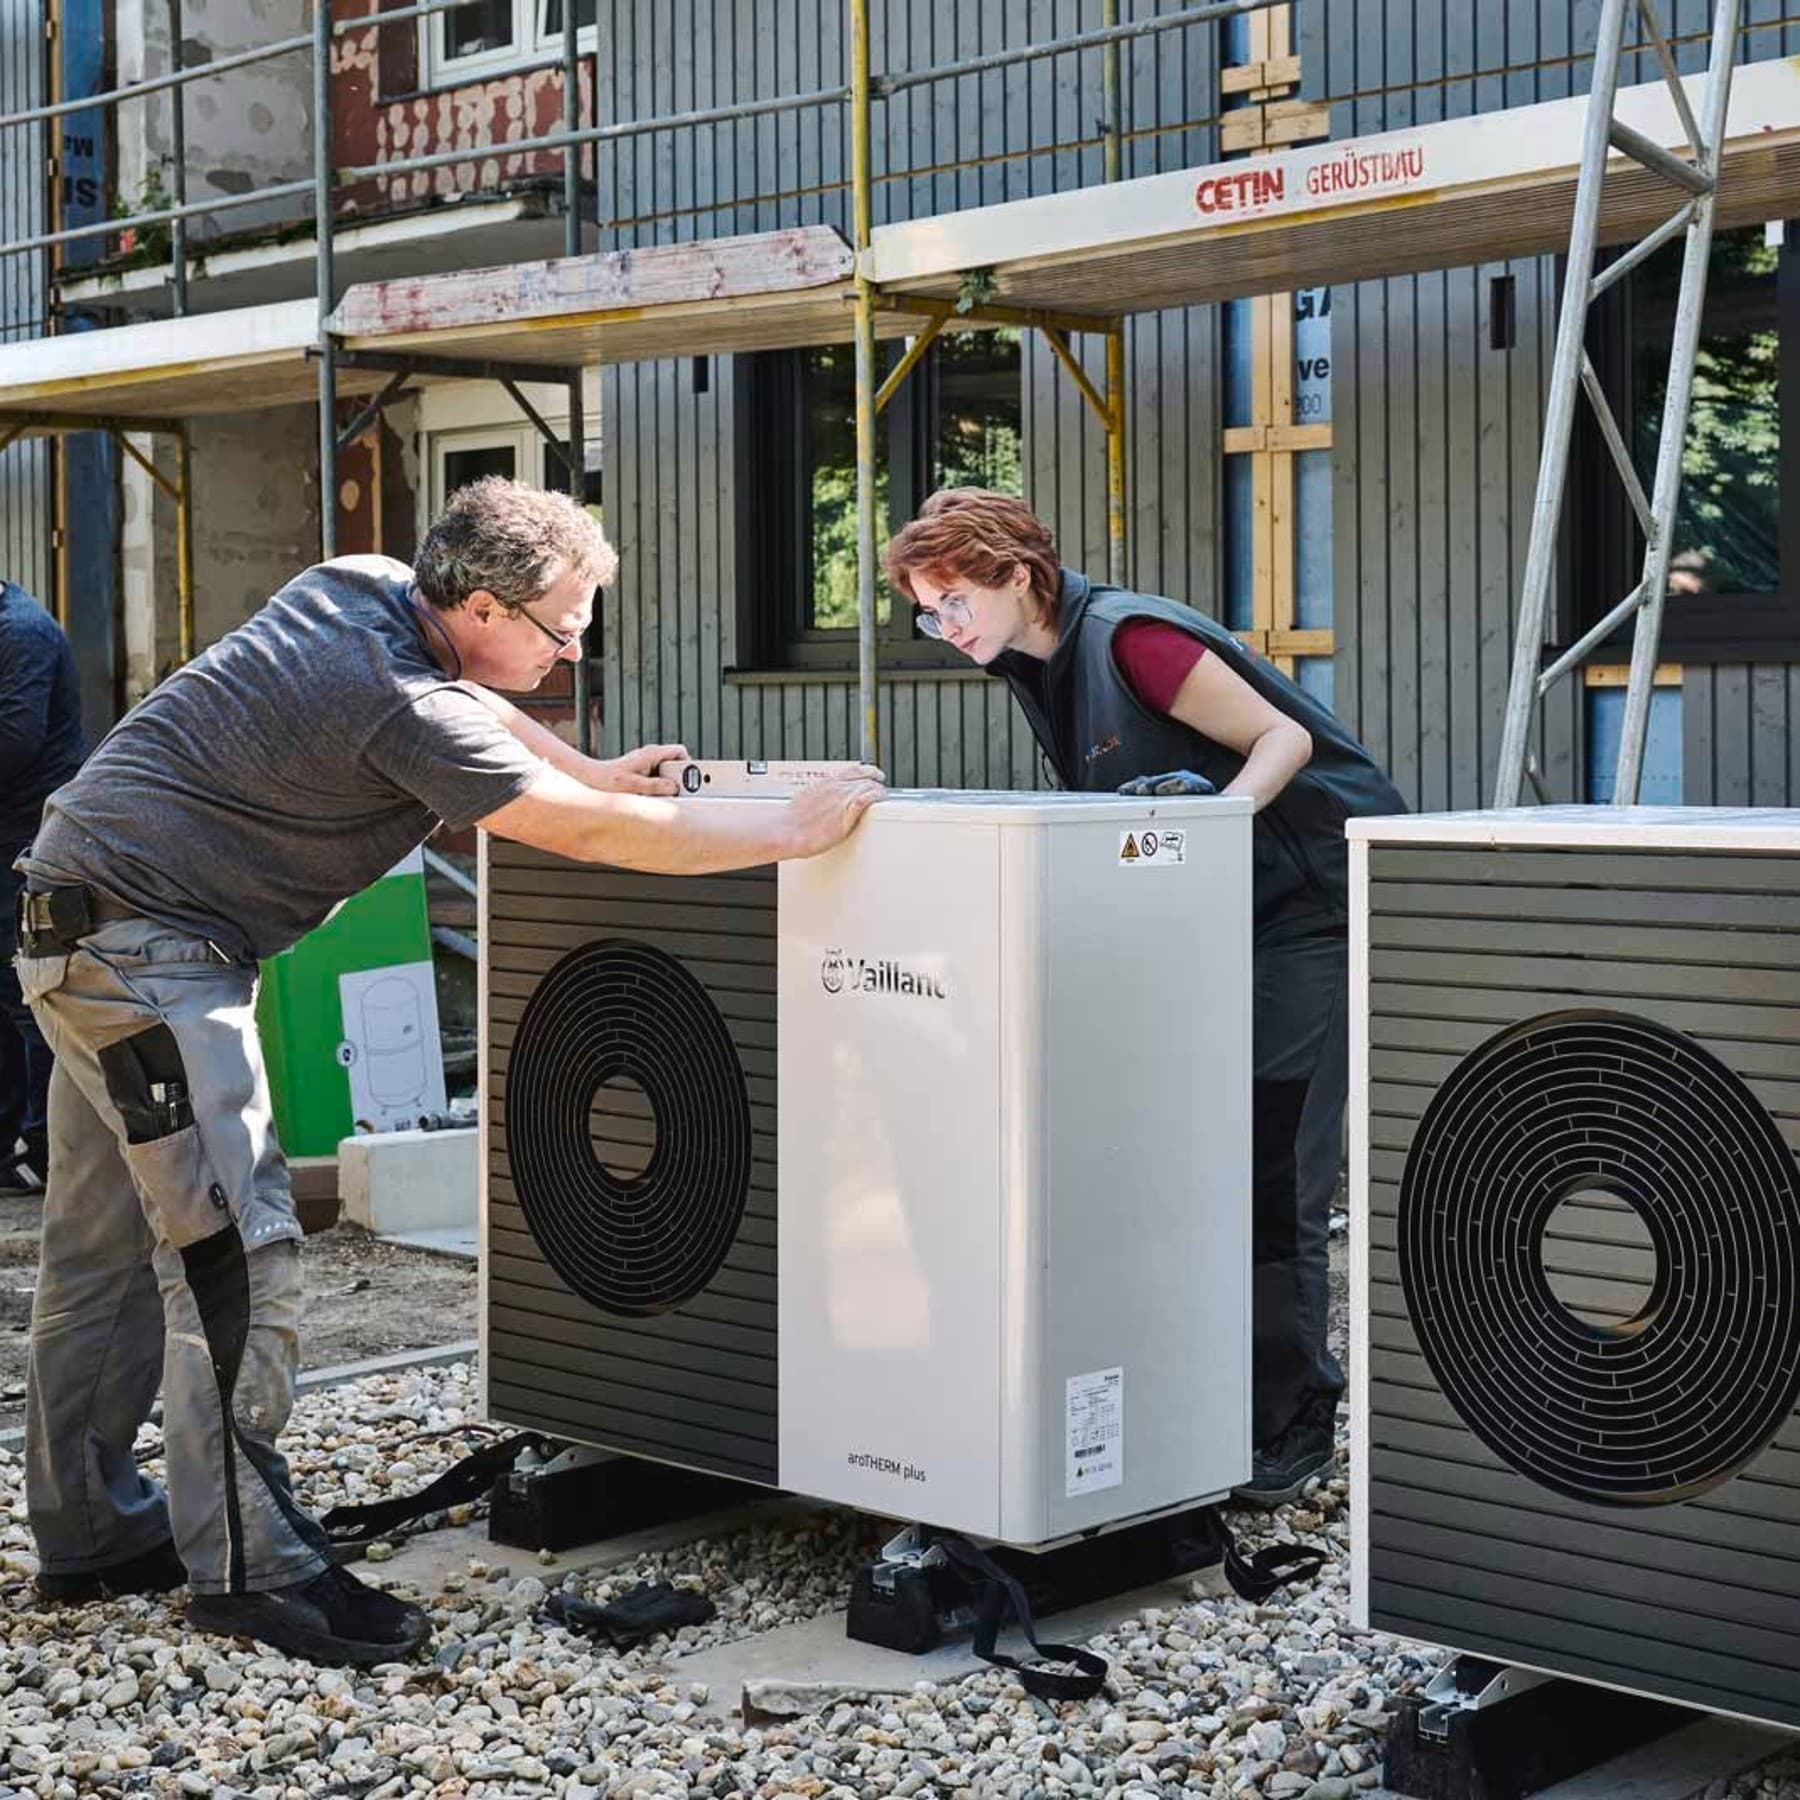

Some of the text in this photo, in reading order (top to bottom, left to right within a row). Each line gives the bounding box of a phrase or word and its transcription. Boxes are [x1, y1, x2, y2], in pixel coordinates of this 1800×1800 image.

[1196, 147, 1423, 214] CETIN GERÜSTBAU
[847, 957, 945, 999] Vaillant
[903, 1464, 926, 1483] plus
